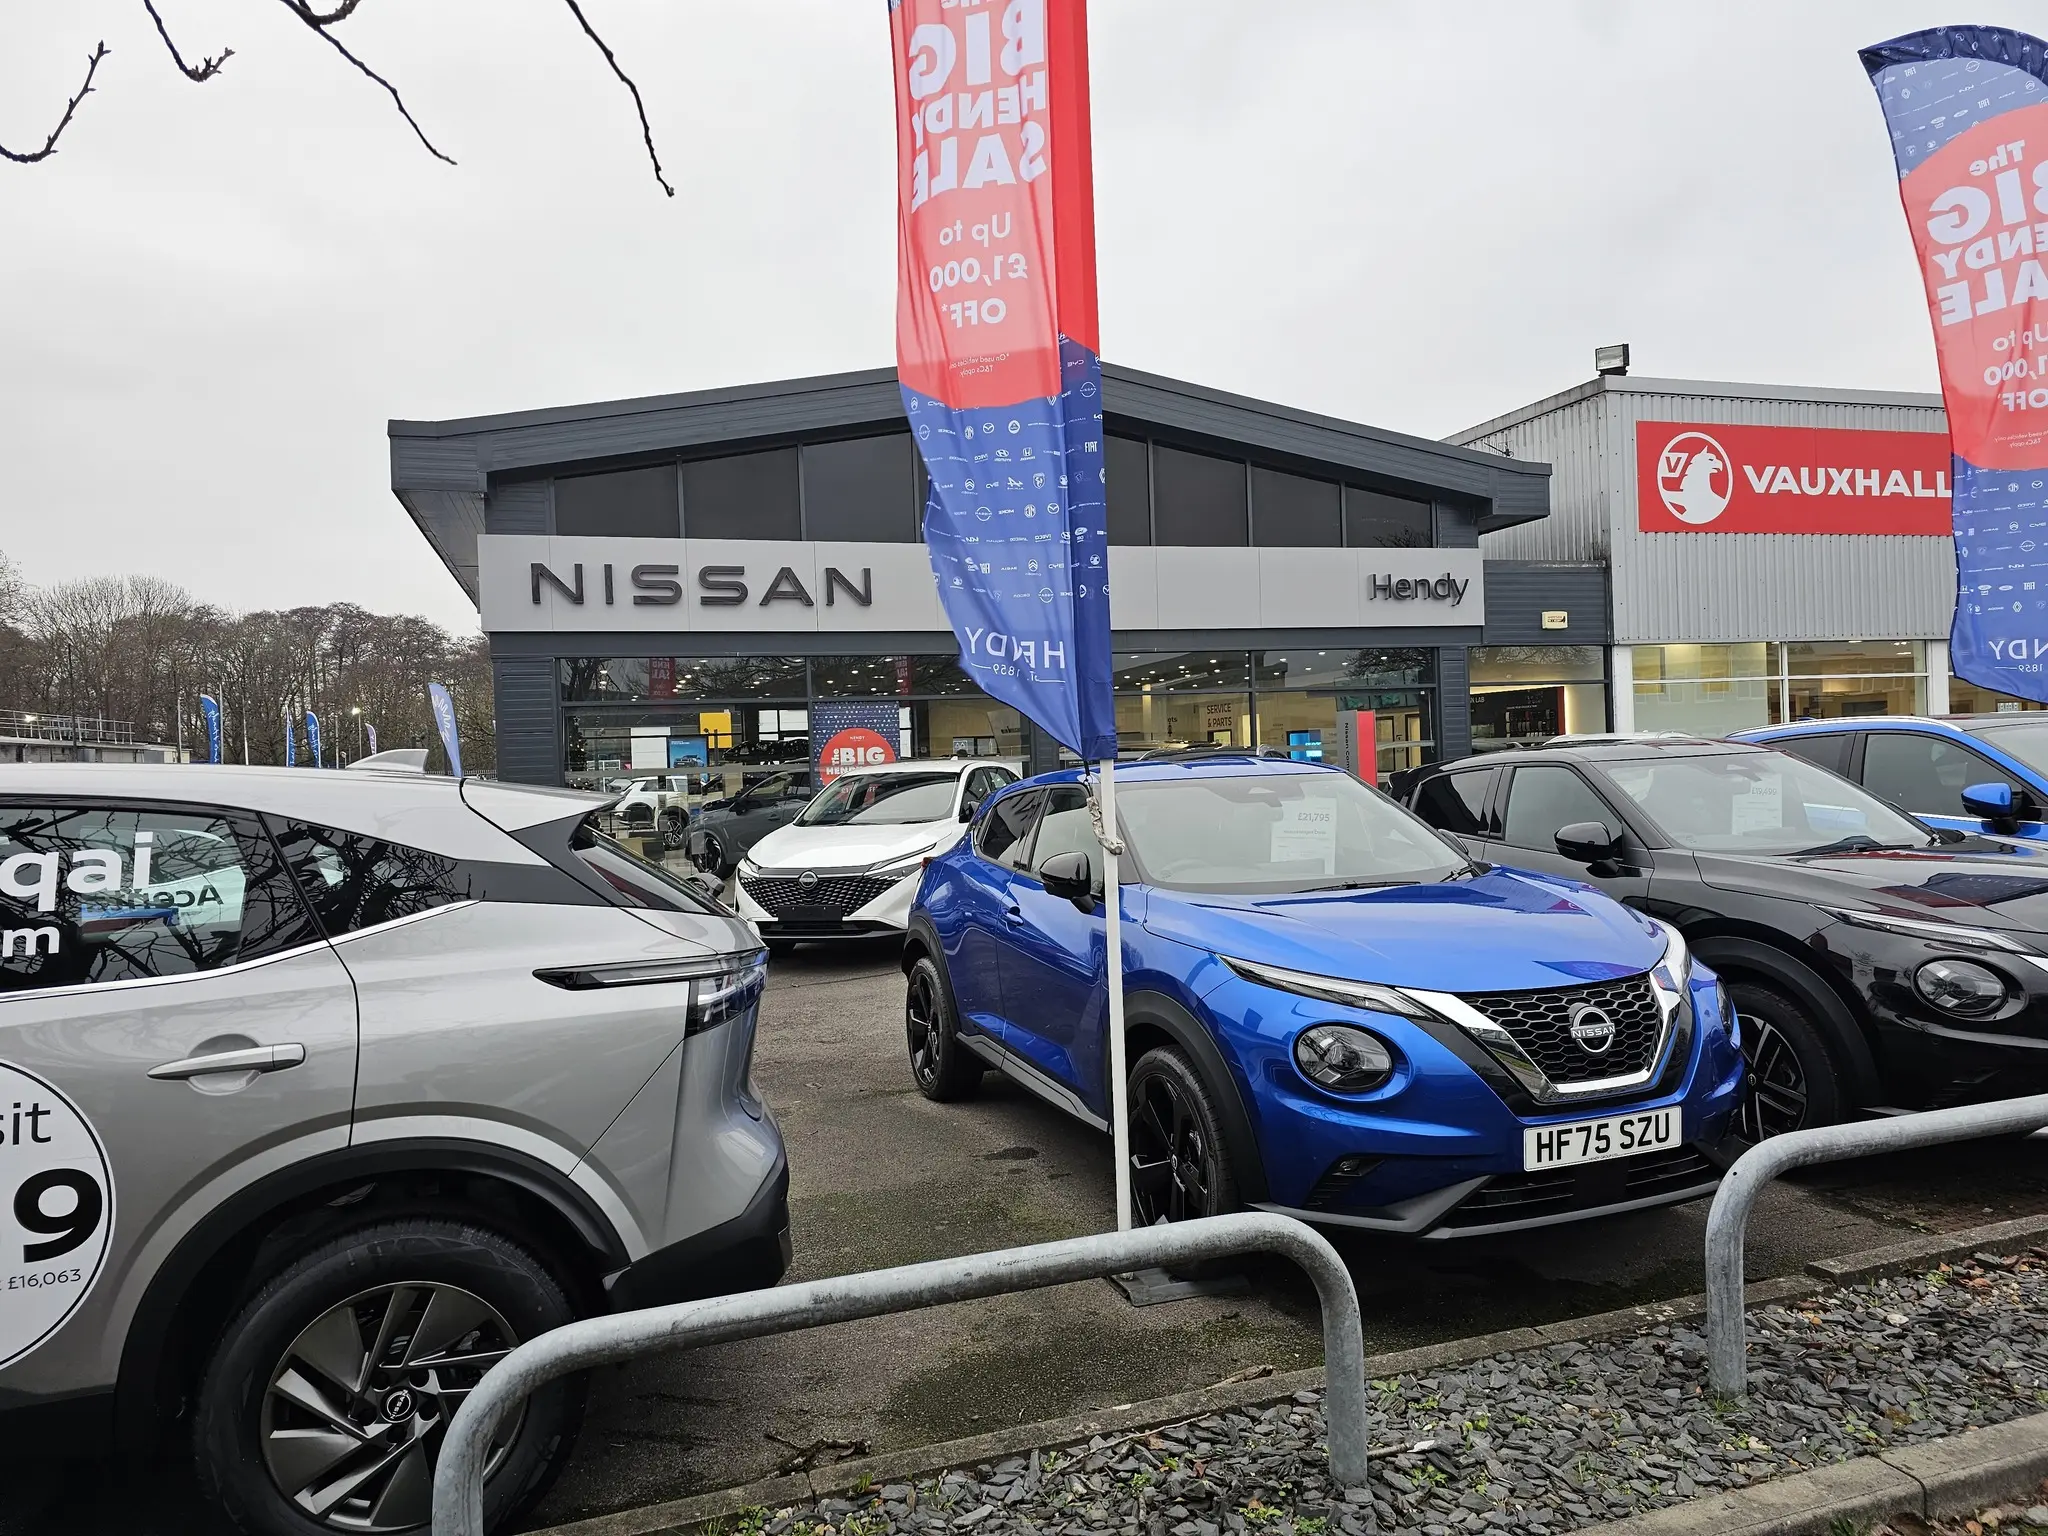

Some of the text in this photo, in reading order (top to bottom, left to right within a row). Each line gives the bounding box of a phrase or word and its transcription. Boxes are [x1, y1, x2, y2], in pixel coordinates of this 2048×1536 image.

[1085, 441, 1098, 453] FIAT
[1741, 464, 1953, 499] VAUXHALL
[530, 562, 873, 607] NISSAN
[1367, 572, 1470, 607] Hendy
[1207, 703, 1232, 714] SERVICE
[1208, 717, 1232, 727] & PARTS
[831, 746, 886, 766] the BIG
[1297, 812, 1330, 822] £21,795
[0, 831, 153, 912] qai
[2, 925, 60, 958] m
[1572, 1023, 1616, 1039] NISSAN
[1536, 1112, 1670, 1163] HF75 SZU
[13, 1168, 102, 1263] 9
[7, 1268, 82, 1290] £16,063
